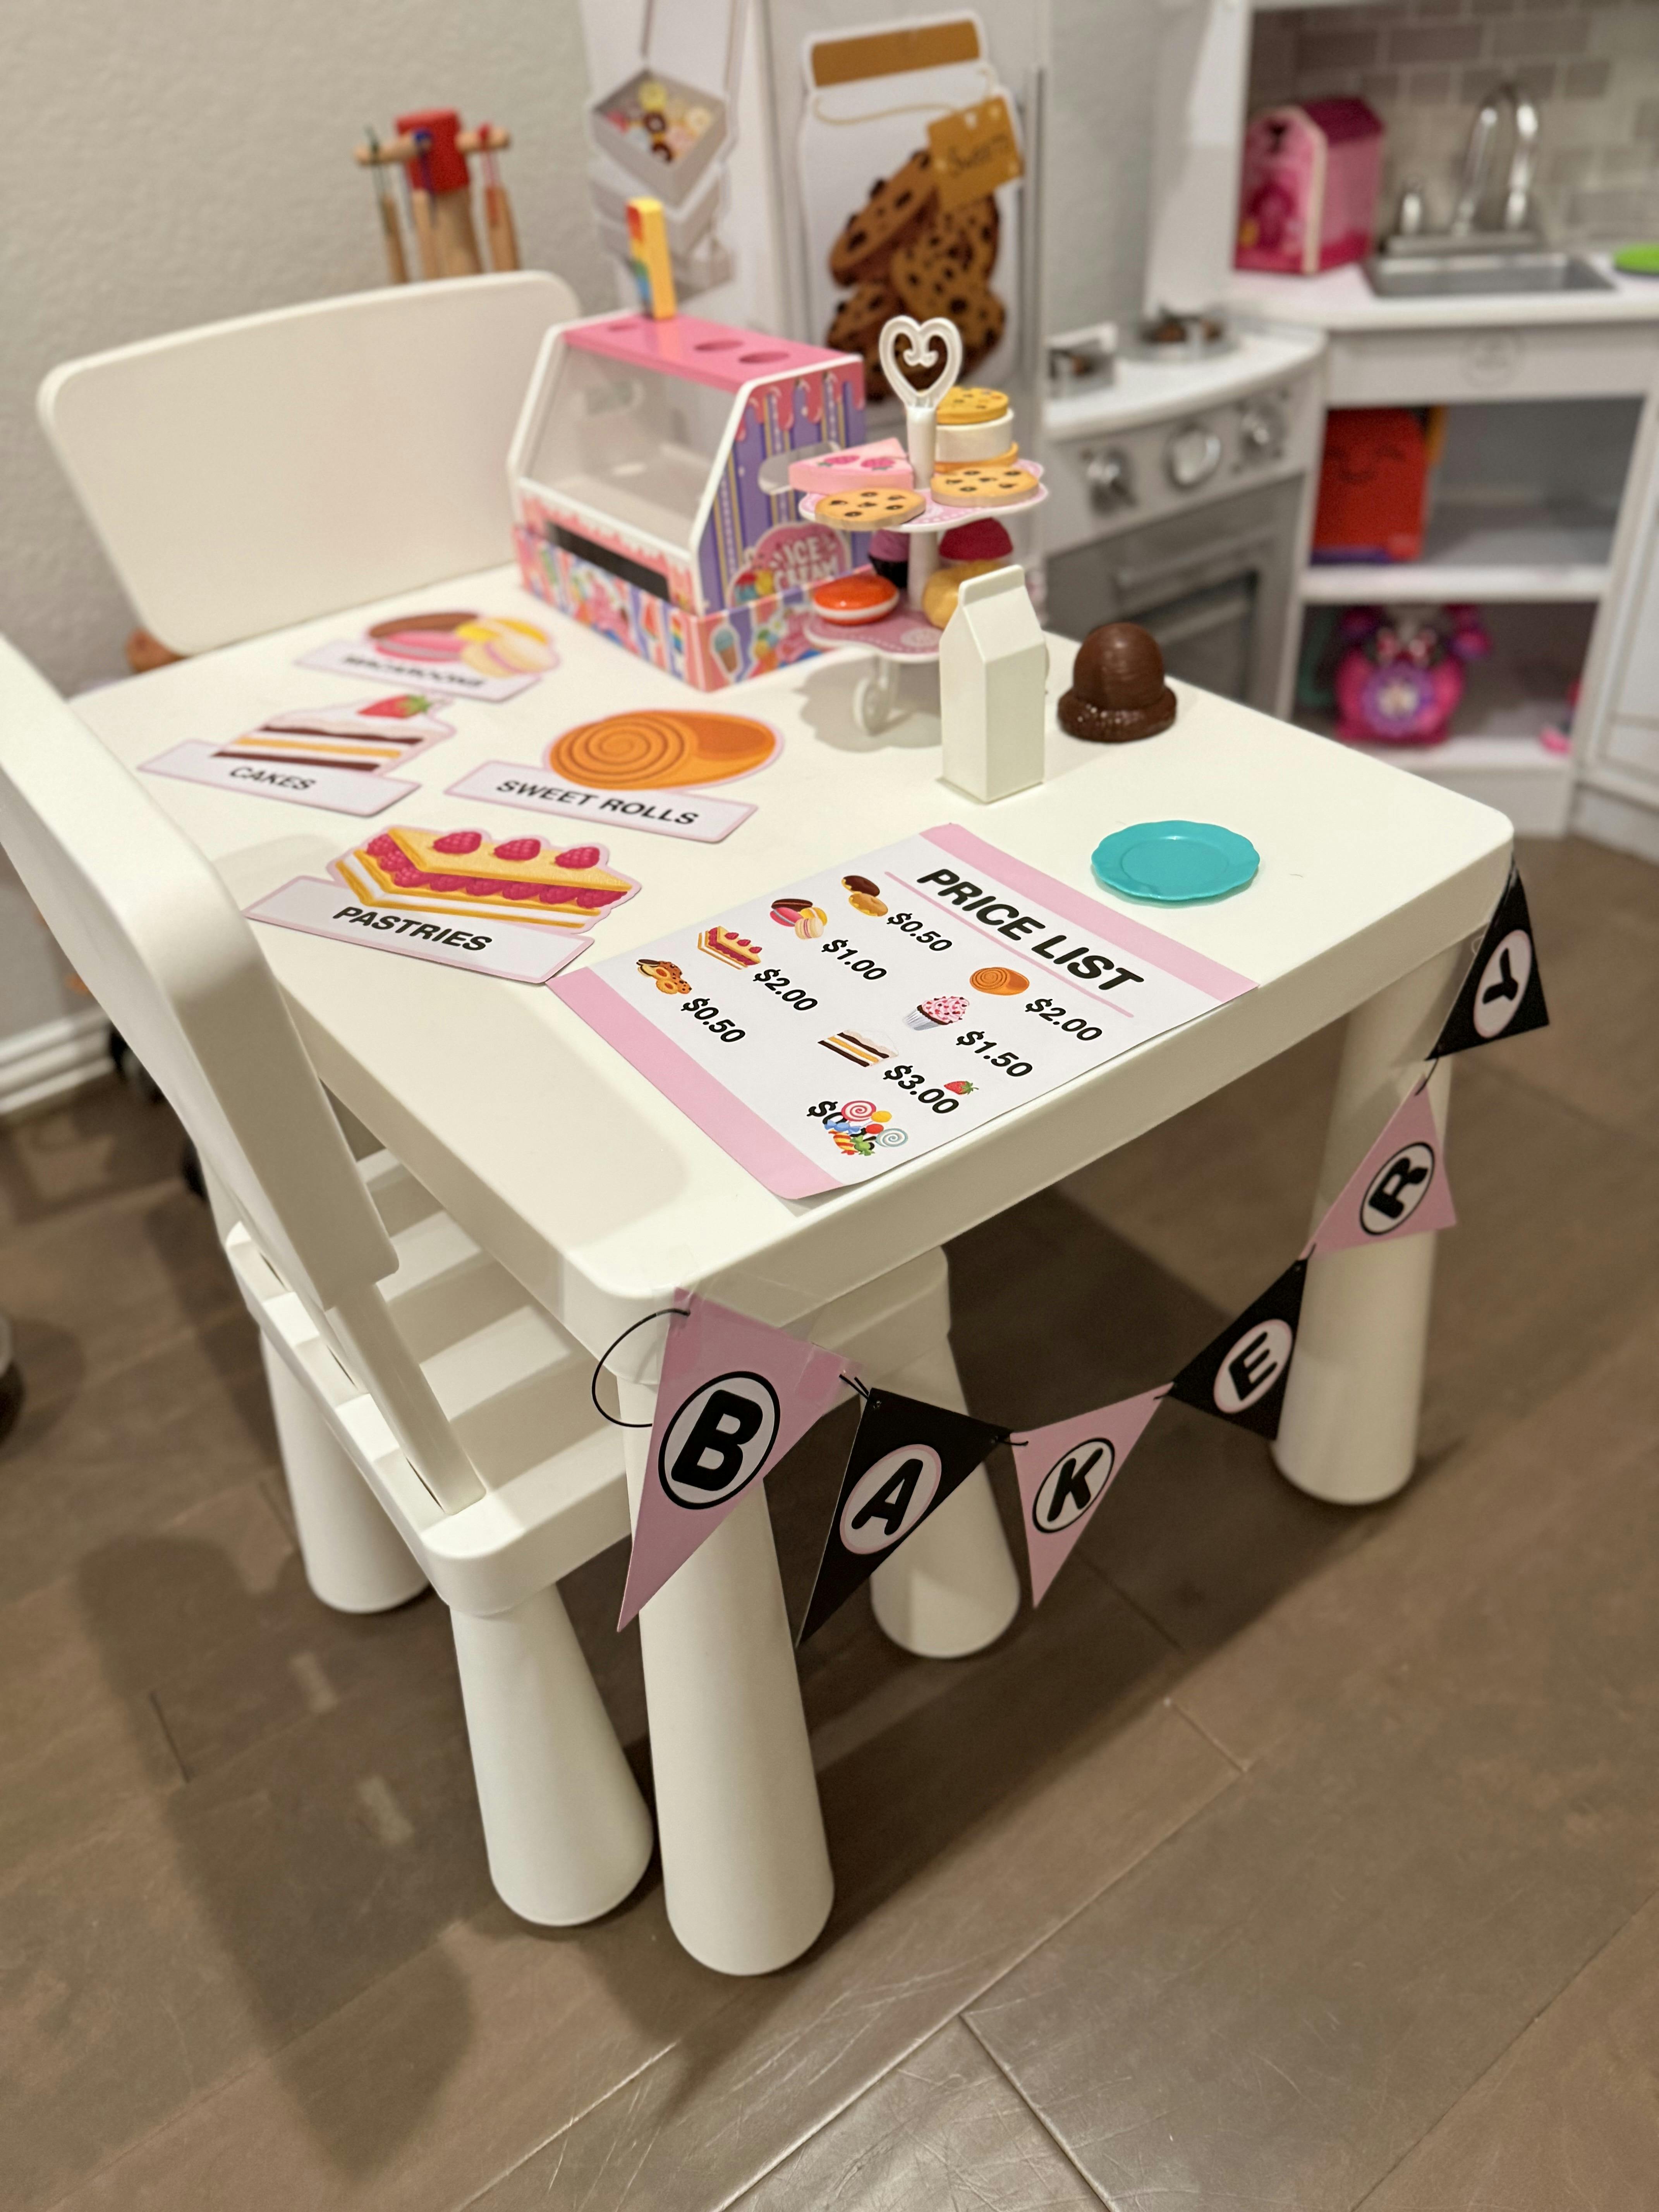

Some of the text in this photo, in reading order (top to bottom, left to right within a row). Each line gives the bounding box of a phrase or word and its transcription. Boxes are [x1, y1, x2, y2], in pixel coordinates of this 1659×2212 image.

[229, 766, 316, 791] CAKES
[496, 780, 699, 825] SWEET ROLLS
[331, 905, 493, 953] PASTRIES
[886, 912, 953, 951] $0.50
[916, 869, 1145, 990] PRICE LIST
[821, 939, 887, 981] $1.00
[752, 969, 818, 1011] $2.00
[680, 998, 746, 1043] $0.50
[1024, 998, 1103, 1041] $2.00
[955, 1030, 1033, 1077] $1.50
[882, 1065, 960, 1114] $3.00
